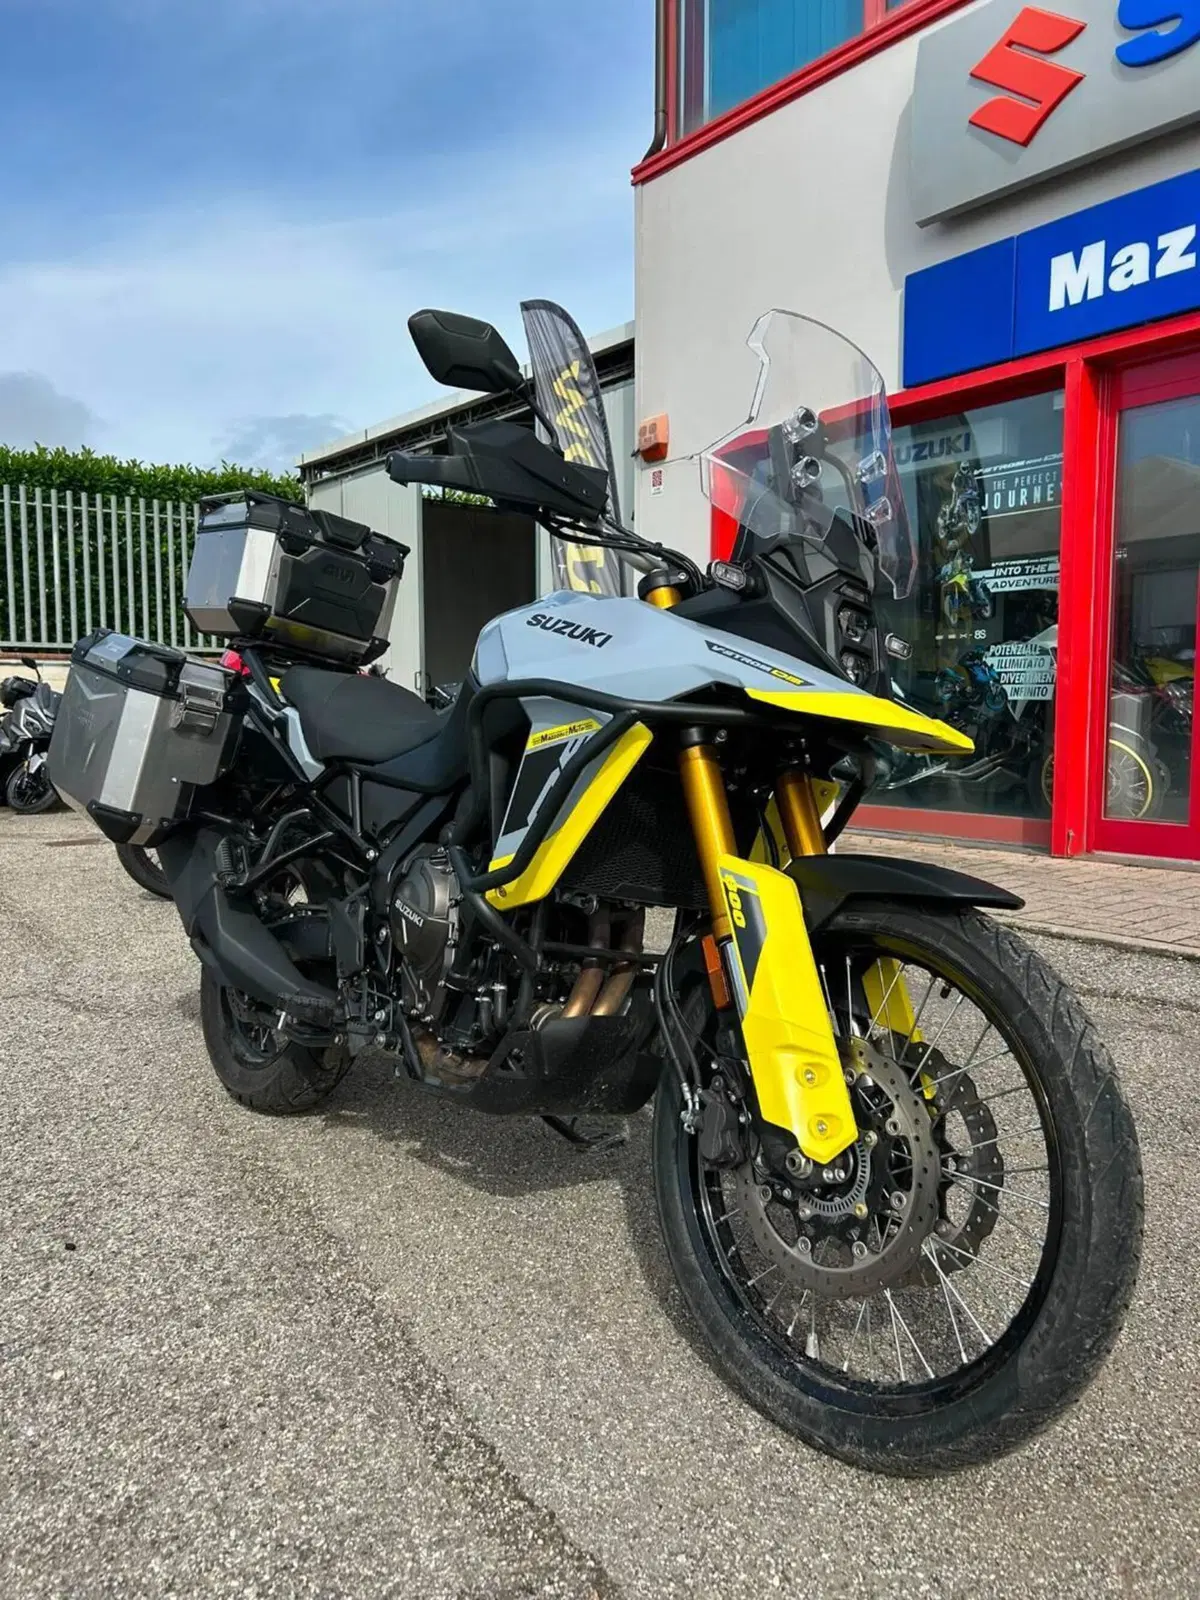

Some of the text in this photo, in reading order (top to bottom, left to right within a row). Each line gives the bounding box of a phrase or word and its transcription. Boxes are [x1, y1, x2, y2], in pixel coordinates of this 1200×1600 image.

[1049, 224, 1196, 312] Maz
[993, 471, 1058, 491] THE PERFECT
[981, 482, 1065, 512] JOURNE
[995, 563, 1048, 577] INTO THE
[991, 576, 1060, 590] ADVENTURE
[526, 613, 613, 648] SUZUKI
[711, 644, 773, 673] V-STROM
[989, 644, 1041, 657] POTENZIALE
[996, 658, 1045, 670] ILLIMITATO
[1009, 686, 1049, 698] INFINITO
[395, 899, 424, 927] SUZUKI
[722, 873, 746, 929] 800
